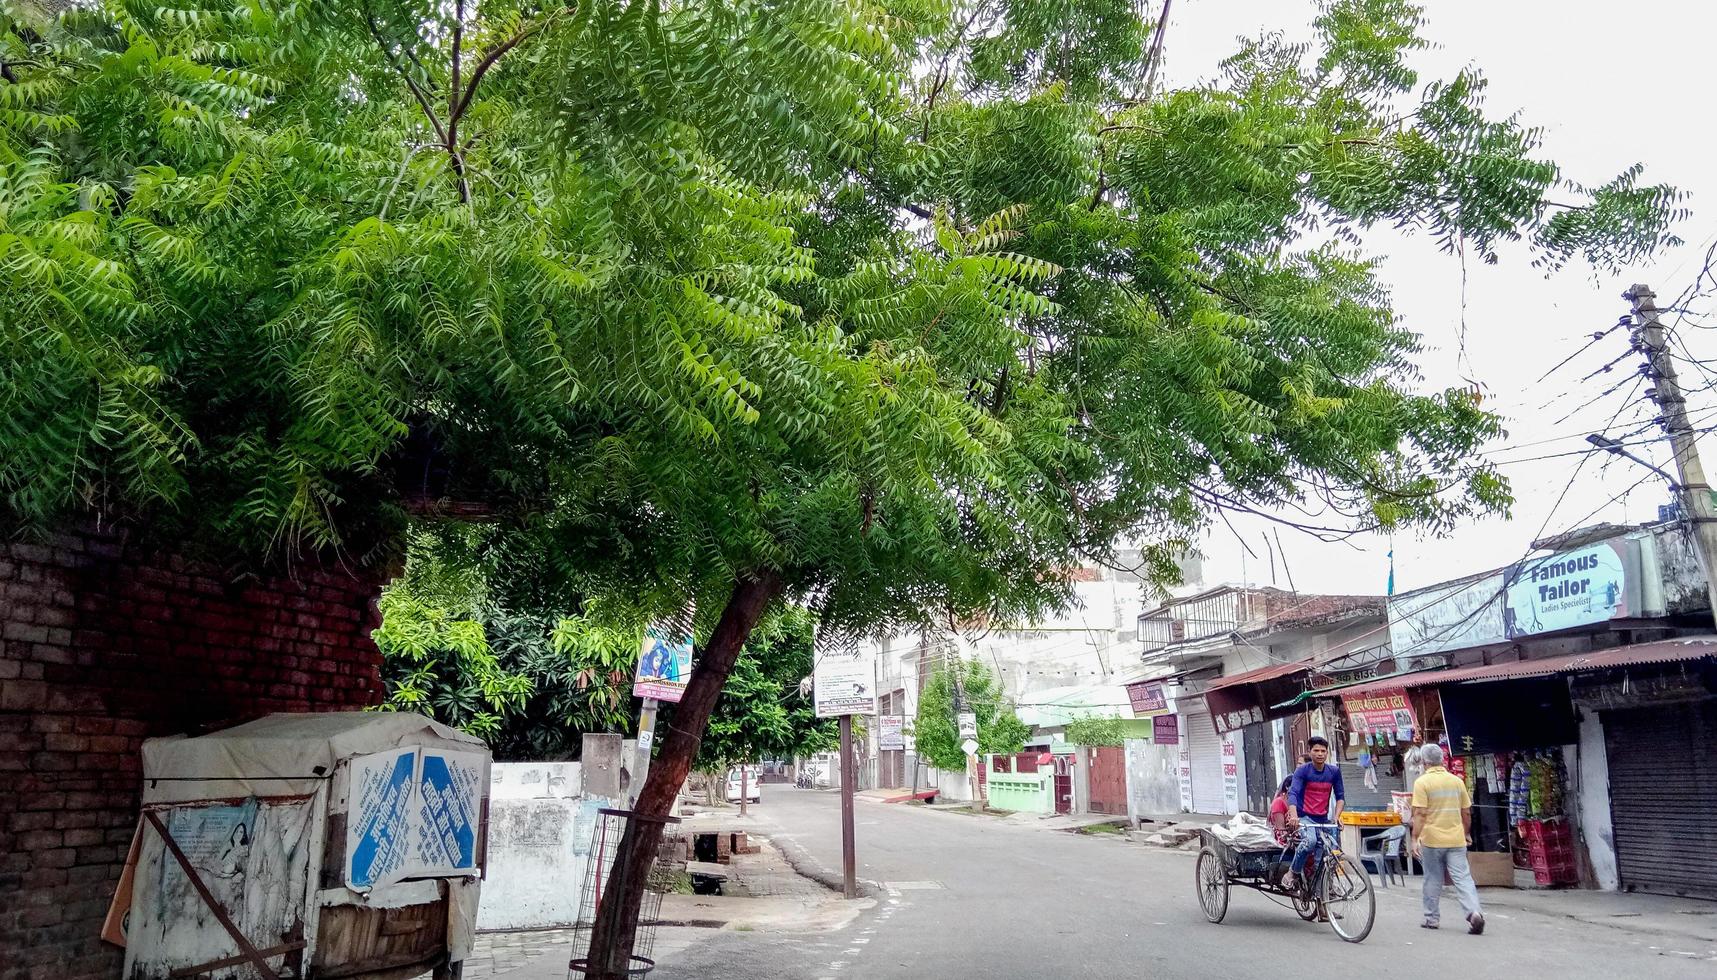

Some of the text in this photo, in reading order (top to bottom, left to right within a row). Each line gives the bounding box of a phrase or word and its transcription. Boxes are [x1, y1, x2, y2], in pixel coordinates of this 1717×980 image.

[1531, 553, 1599, 583] Famous
[1539, 577, 1590, 602] Tailor
[1541, 601, 1559, 614] Ladies
[436, 810, 450, 834] और
[366, 837, 390, 883] लाइब्रेरी
[387, 815, 399, 840] और
